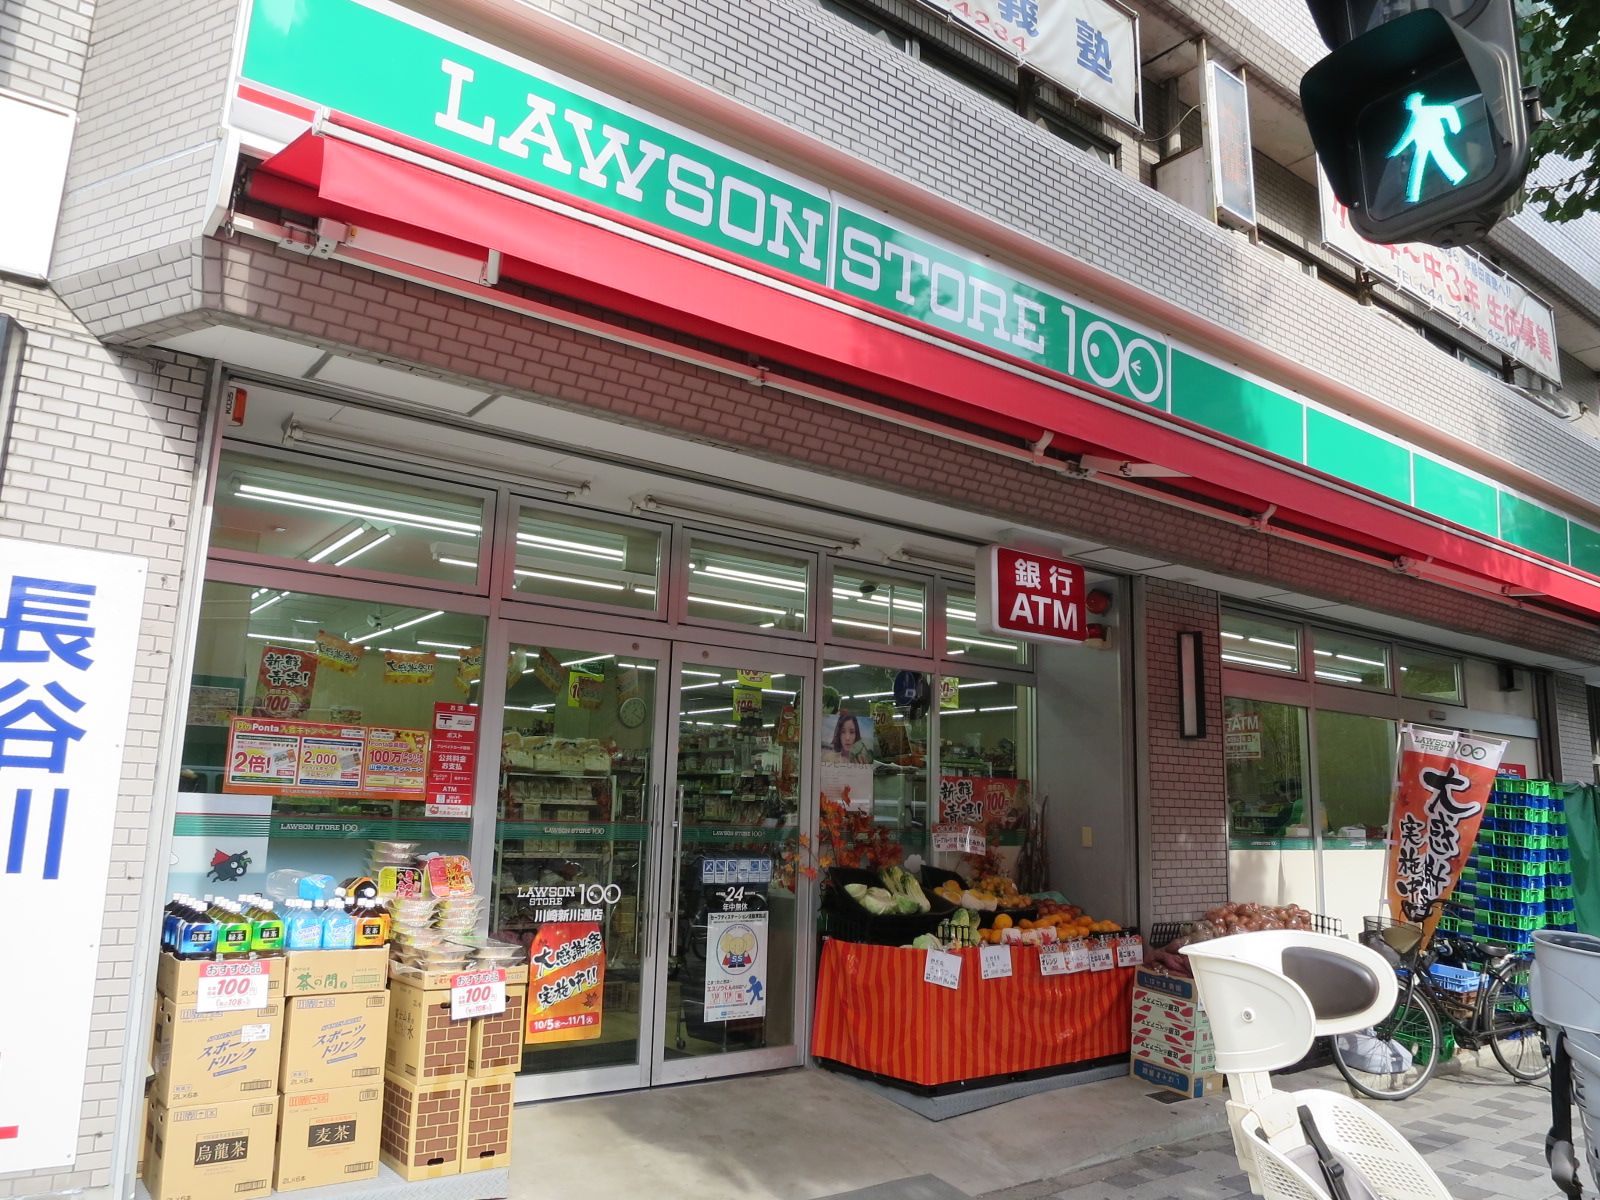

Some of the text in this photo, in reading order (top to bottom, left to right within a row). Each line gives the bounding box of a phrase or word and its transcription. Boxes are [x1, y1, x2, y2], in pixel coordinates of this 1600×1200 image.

[434, 58, 1163, 403] LAWSON STORE 100
[1014, 558, 1073, 596] 銀行
[1009, 592, 1078, 632] ATM
[264, 652, 302, 670] 新鮮
[1414, 735, 1487, 761] LAWSON 100
[234, 751, 271, 774] 2倍!
[939, 779, 973, 802] 新鮮
[280, 823, 314, 831] LAWSON
[342, 824, 358, 832] 100
[517, 883, 622, 905] LAWSON 100
[529, 897, 563, 906] STORE
[725, 886, 745, 902] 24
[534, 908, 604, 923] 川崎新川通店
[722, 903, 748, 912] 年中無休
[533, 932, 602, 976] 大感謝祭
[207, 963, 261, 976] おすすめ品
[456, 970, 500, 987] おすすめ品
[311, 1023, 367, 1048] スポーツ
[321, 1036, 367, 1059] ドリンク
[207, 1047, 257, 1072] ドリンク
[314, 1124, 351, 1145] 麦茶
[195, 1140, 247, 1163] 烏龍茶
